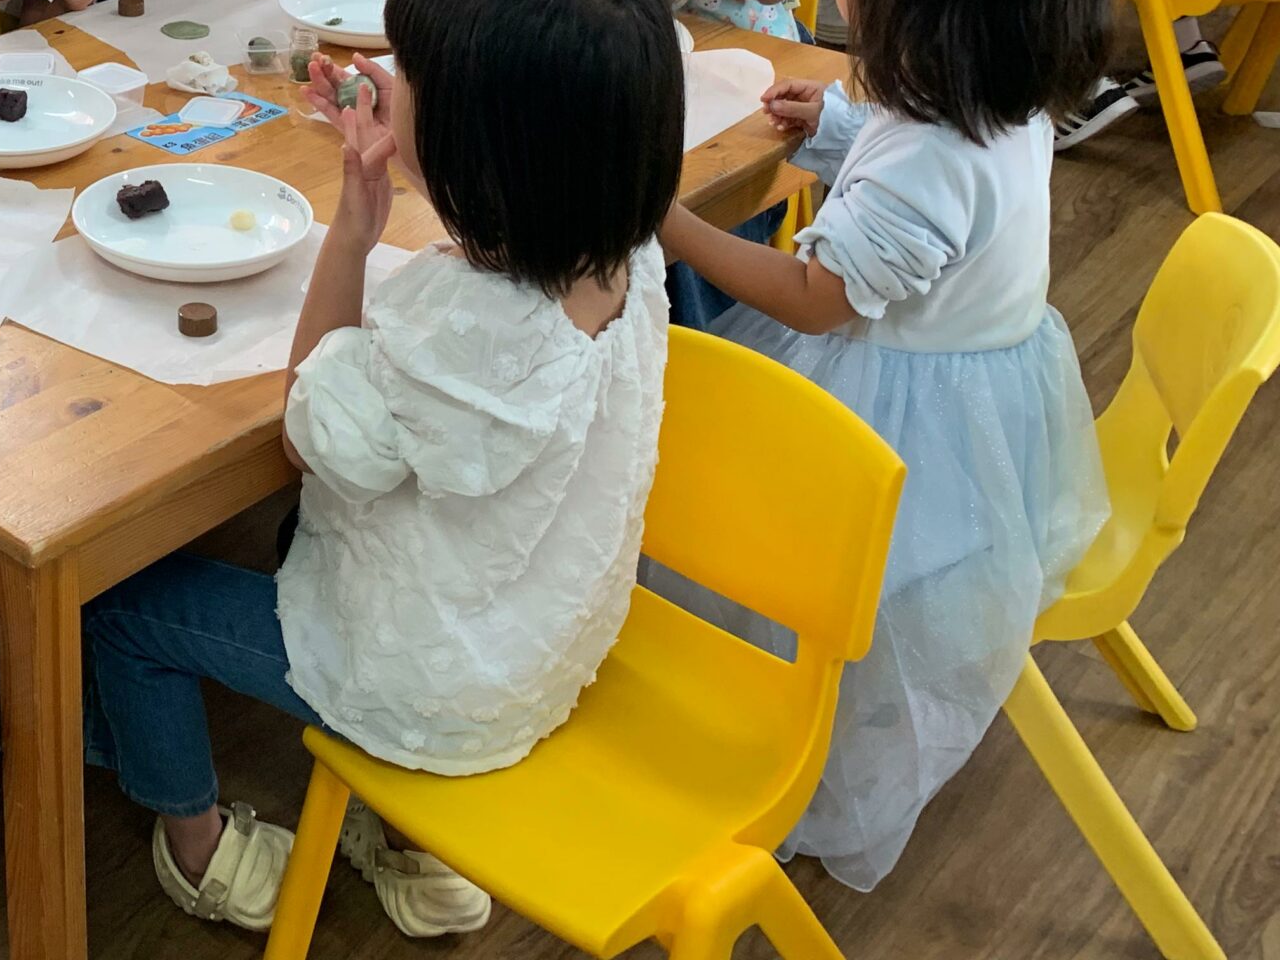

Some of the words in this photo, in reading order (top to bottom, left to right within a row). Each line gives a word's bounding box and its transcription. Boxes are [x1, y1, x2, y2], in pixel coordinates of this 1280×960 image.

[12, 78, 26, 86] me
[26, 80, 44, 88] out!
[162, 140, 178, 150] K3
